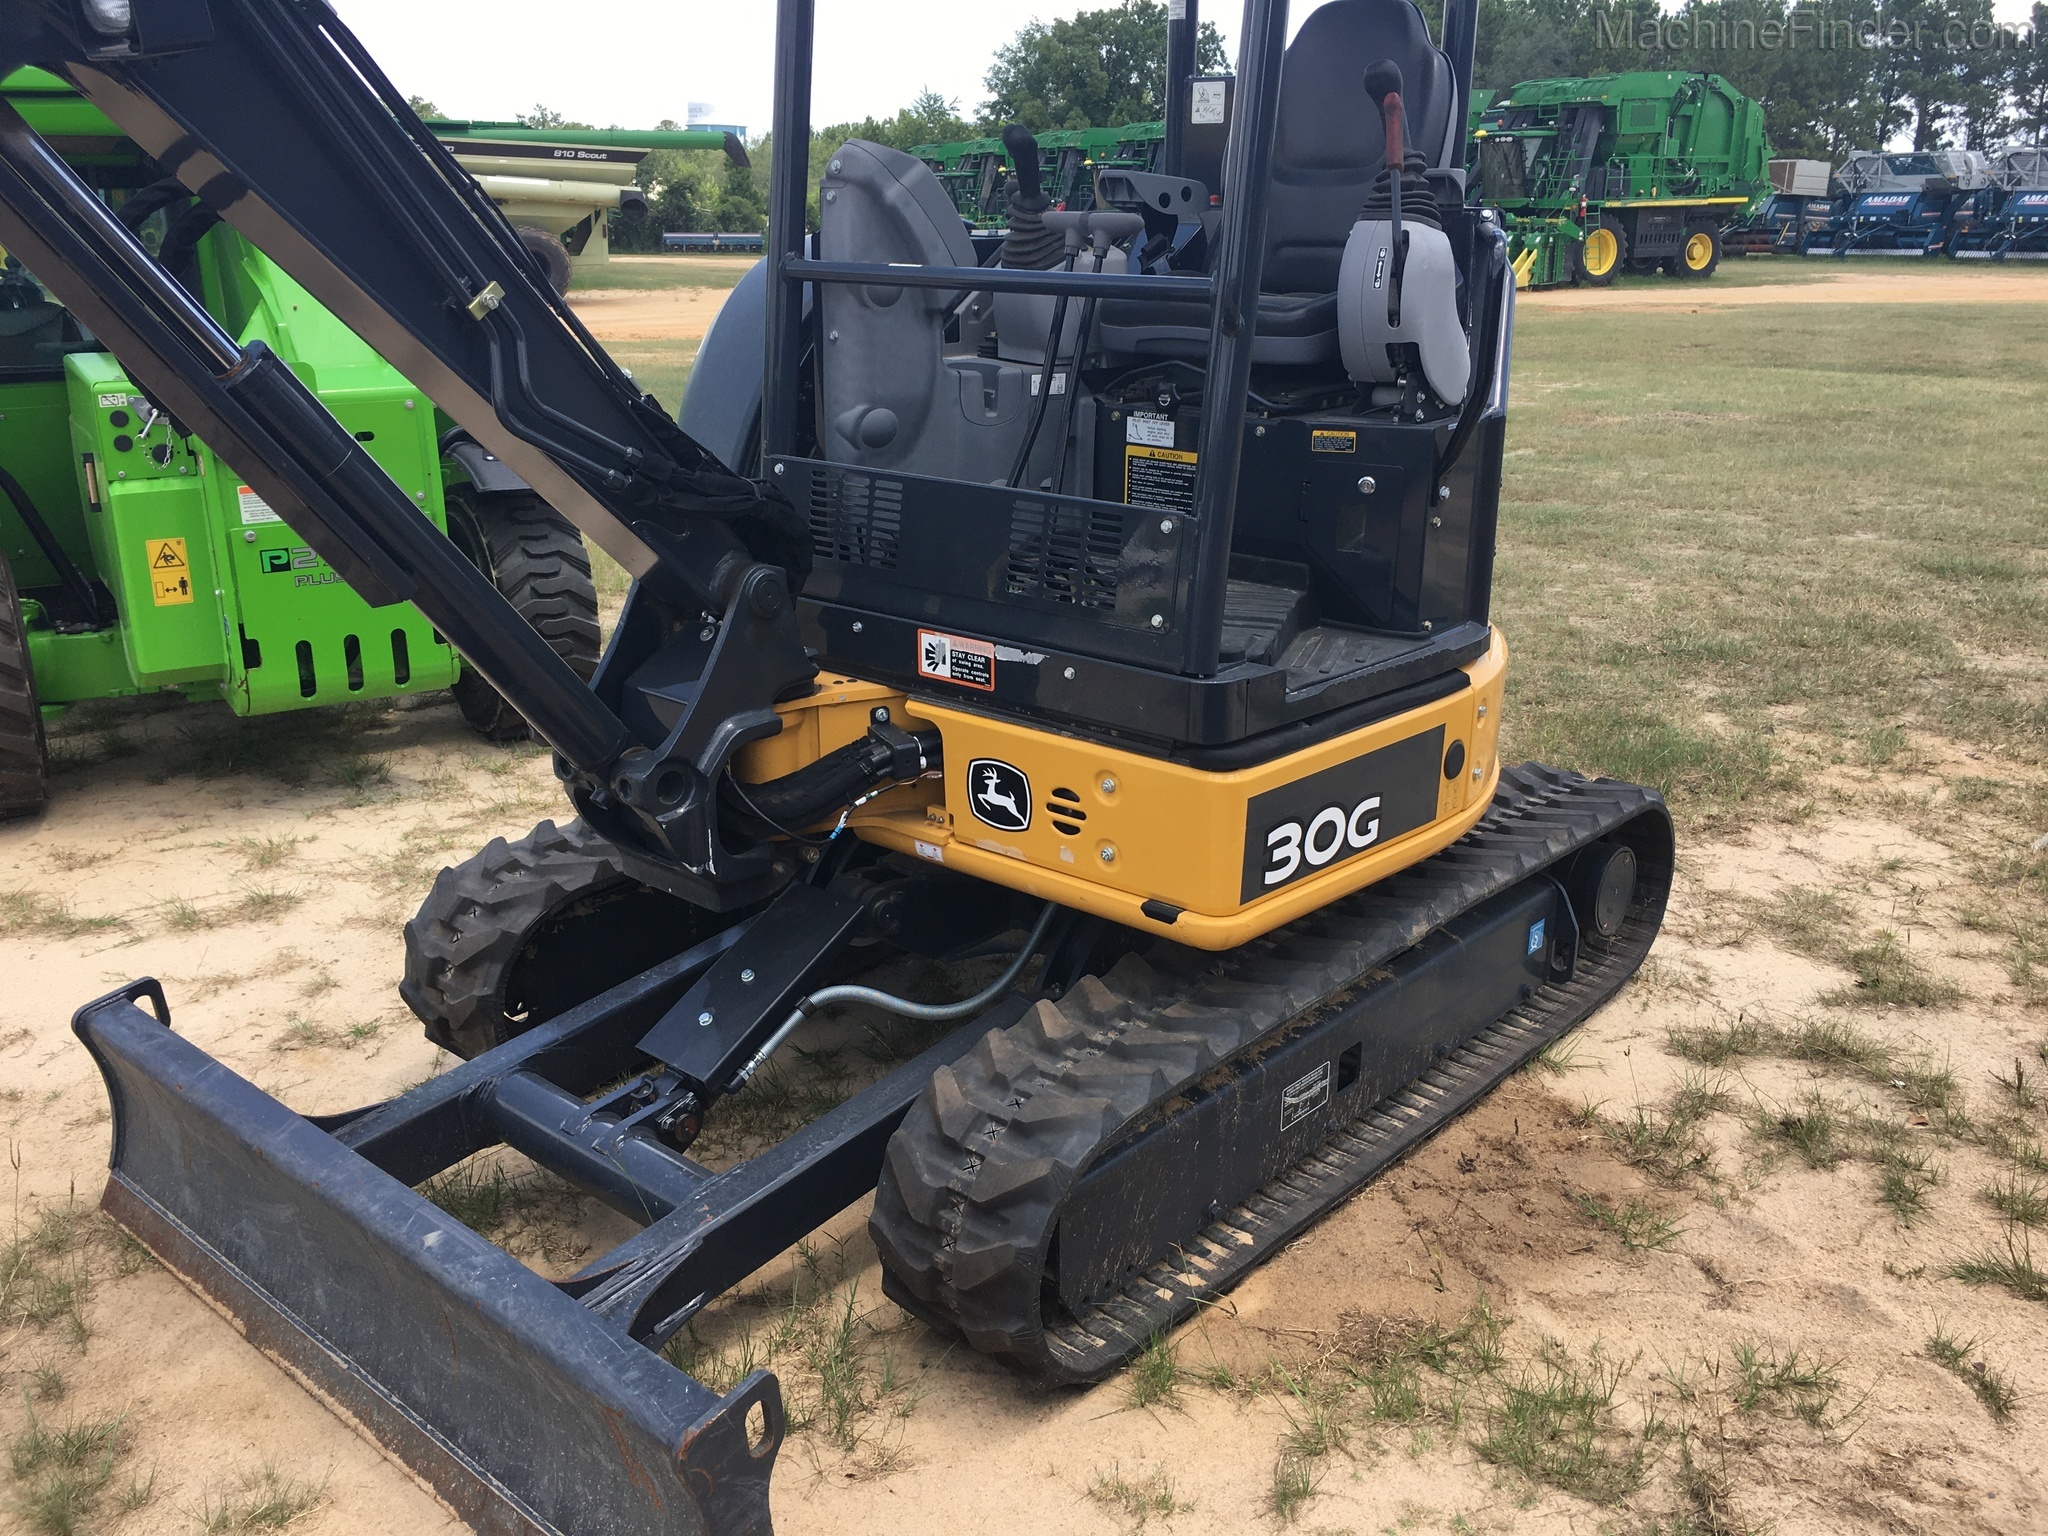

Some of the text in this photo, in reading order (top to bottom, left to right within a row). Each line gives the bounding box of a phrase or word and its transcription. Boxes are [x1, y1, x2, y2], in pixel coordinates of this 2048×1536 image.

[553, 149, 608, 160] 810 Scout
[1863, 195, 1911, 204] AMADAS
[1134, 411, 1169, 420] IMPORTANT
[1157, 452, 1183, 460] CAUTION
[260, 547, 328, 574] P2
[959, 641, 992, 655] WARNING
[952, 651, 986, 663] STAY CLEAR
[952, 665, 969, 673] Operate
[1264, 796, 1381, 885] 30G
